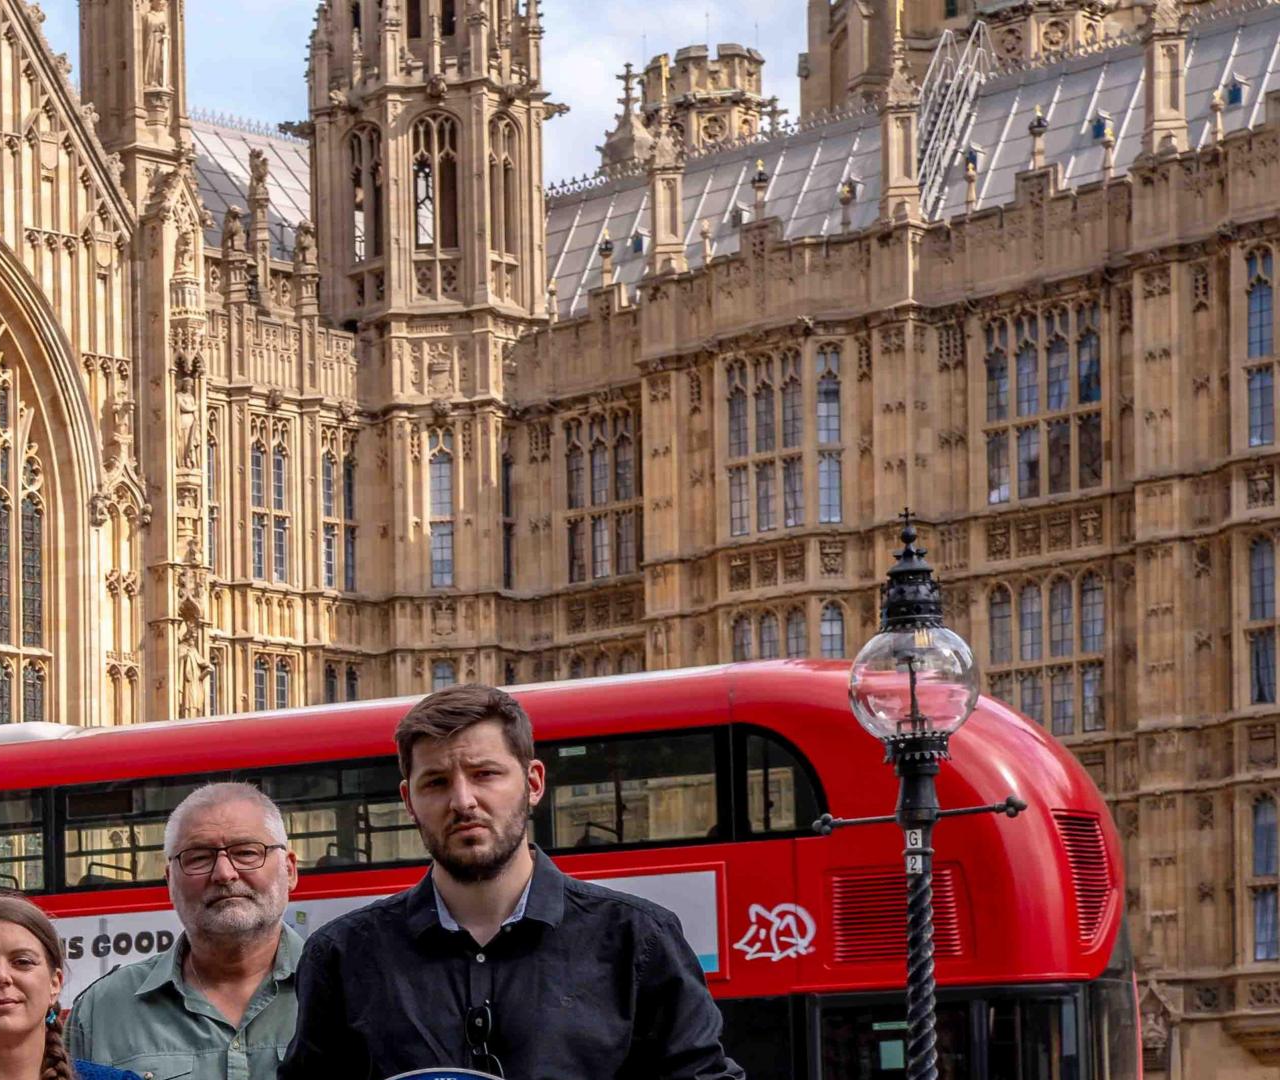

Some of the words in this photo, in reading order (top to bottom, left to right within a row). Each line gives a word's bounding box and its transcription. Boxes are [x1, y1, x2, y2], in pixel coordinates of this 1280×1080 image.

[909, 831, 918, 847] G
[910, 856, 917, 871] 2
[92, 930, 174, 958] GOOD
